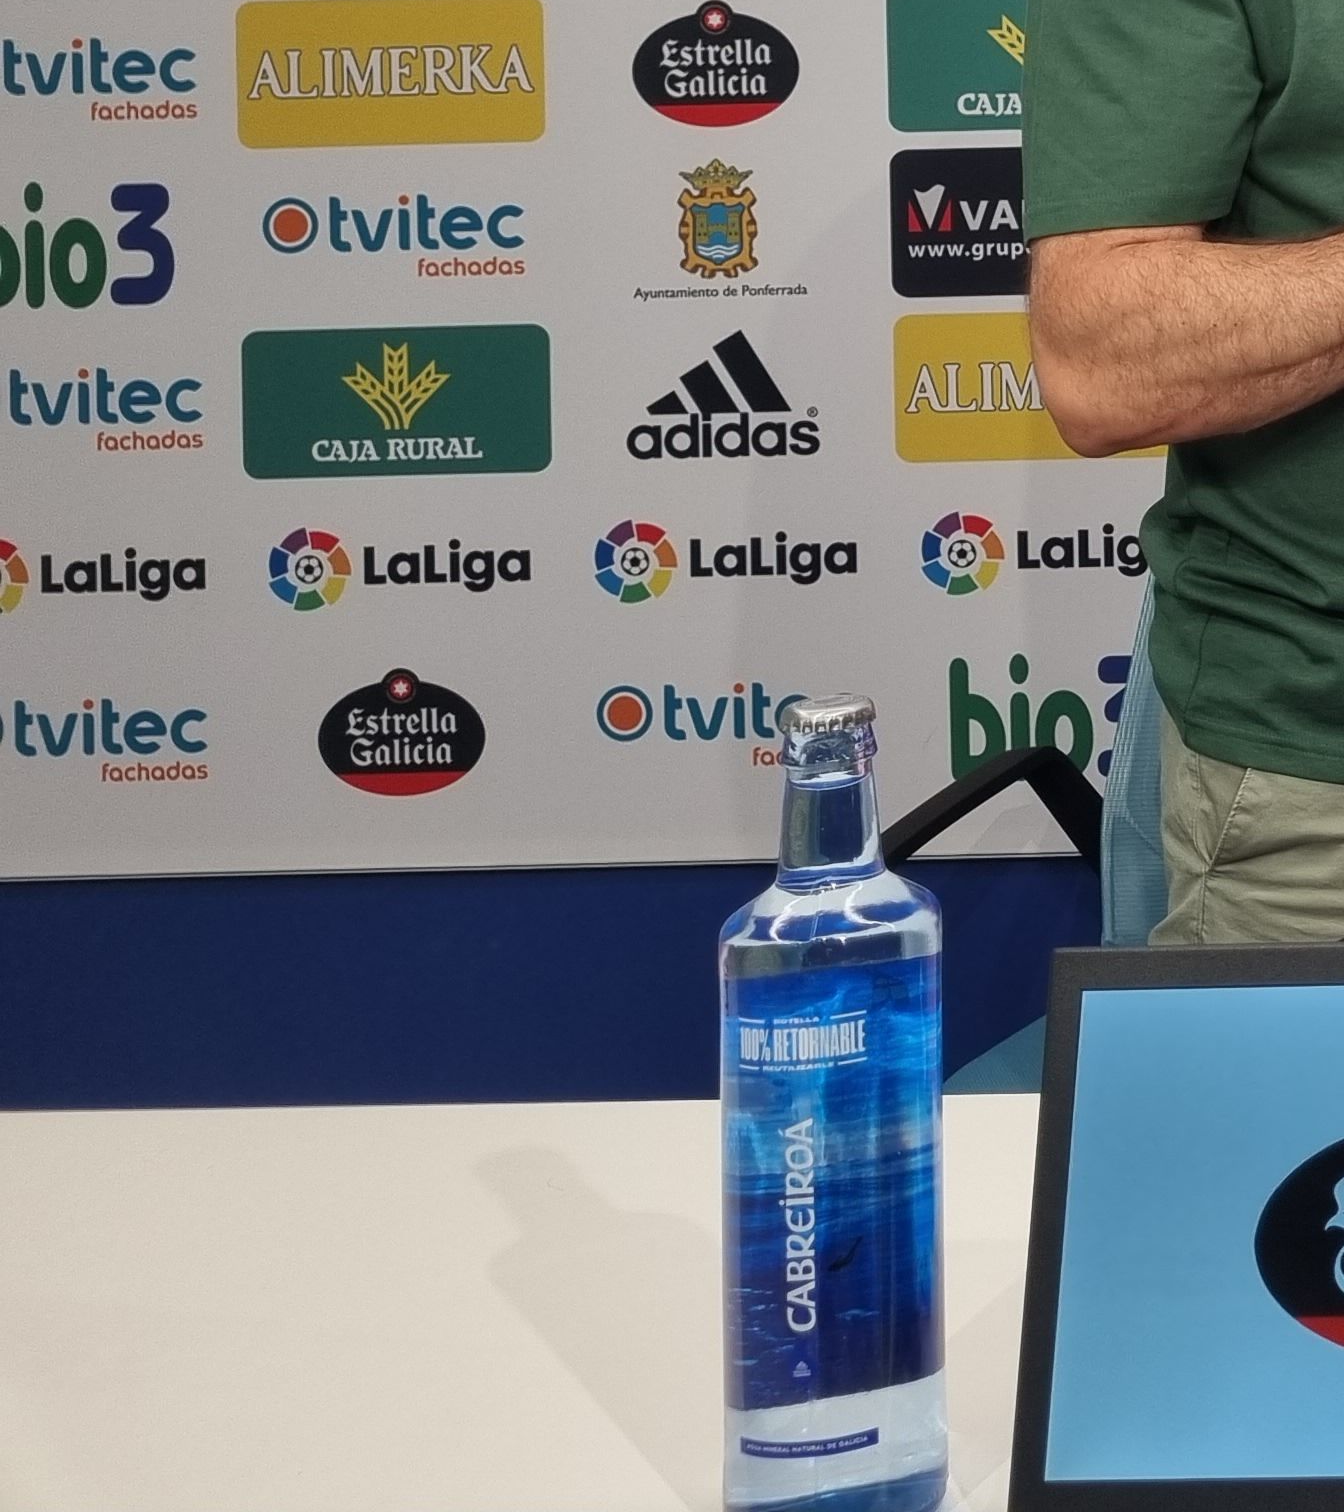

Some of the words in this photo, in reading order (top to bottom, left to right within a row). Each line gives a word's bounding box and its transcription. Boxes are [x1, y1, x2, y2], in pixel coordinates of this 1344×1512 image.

[4, 37, 195, 98] tvitec
[659, 39, 771, 69] Estrella
[249, 44, 533, 101] ALIMERKA
[663, 67, 767, 100] Galicia
[90, 100, 198, 122] fachadas
[957, 92, 1022, 117] CAJA
[328, 193, 525, 254] tvitec
[417, 256, 525, 278] fachadas
[634, 286, 719, 302] Ayuntamiento
[723, 284, 738, 297] de
[742, 283, 807, 297] Ponferrada
[9, 368, 202, 427] tvitec
[96, 429, 203, 451] fachadas
[311, 438, 380, 463] CAJA
[387, 436, 483, 460] RURAL
[626, 410, 821, 460] adidas
[364, 539, 531, 592] LaLiga
[689, 531, 857, 584] LaLiga
[41, 548, 205, 601] LaLiga
[15, 698, 207, 758] tvitec
[345, 708, 457, 737] Estrella
[349, 737, 452, 769] Galicia
[101, 761, 208, 783] fachadas
[740, 1026, 771, 1061] 100%
[773, 1019, 866, 1061] RETORNABLE
